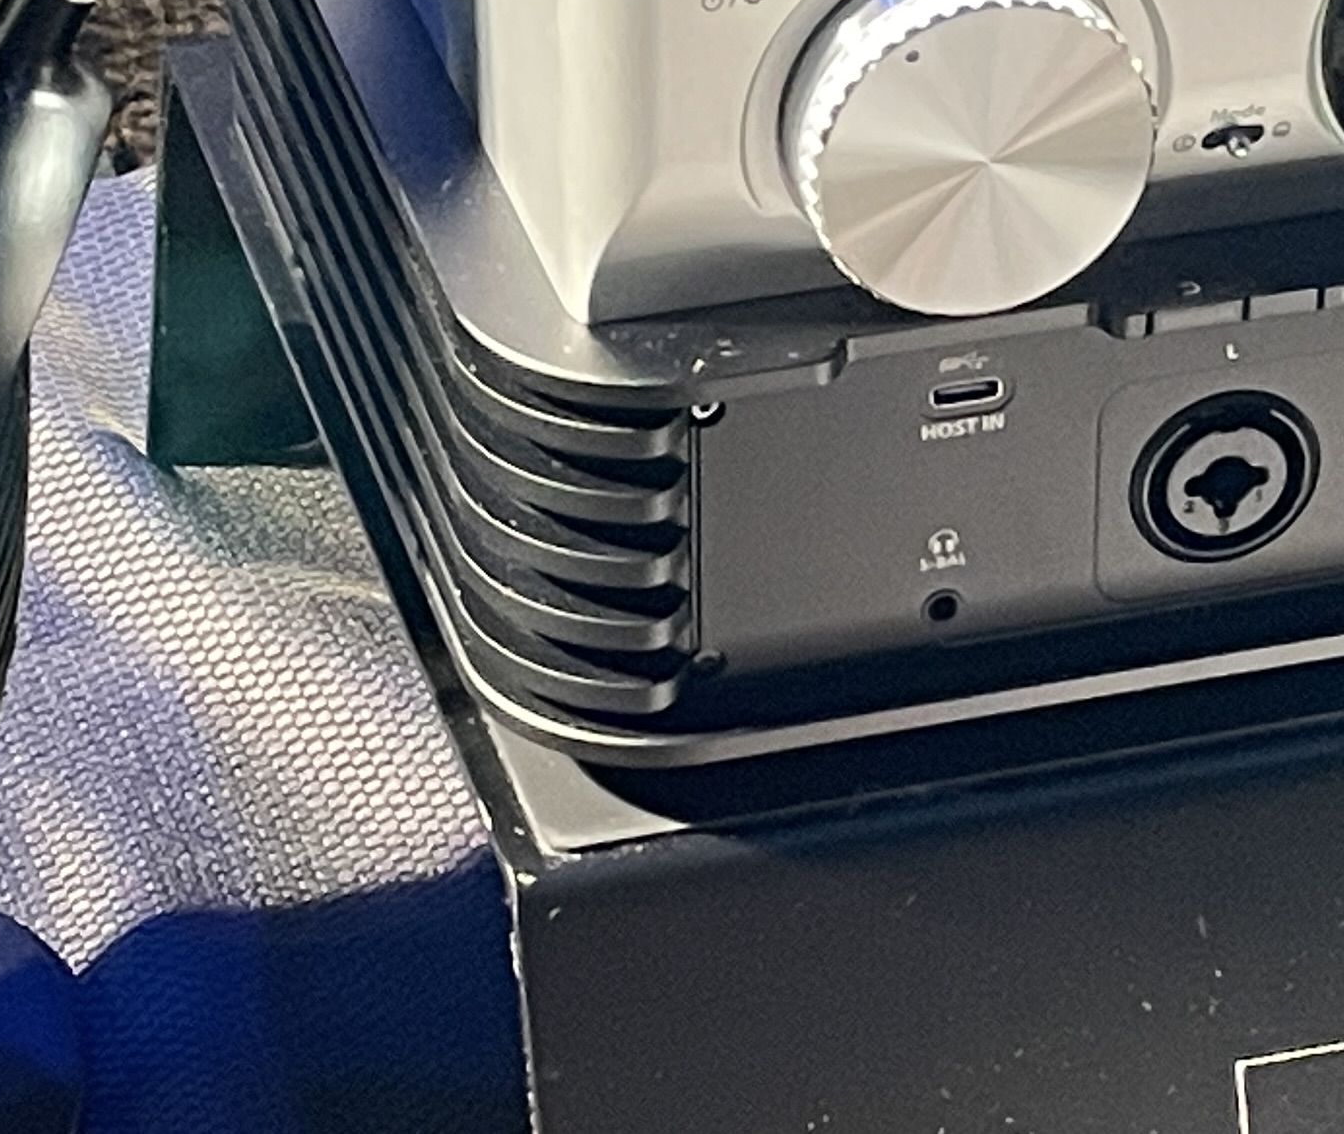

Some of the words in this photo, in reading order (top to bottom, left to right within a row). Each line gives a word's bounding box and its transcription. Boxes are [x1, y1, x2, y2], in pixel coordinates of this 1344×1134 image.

[1226, 342, 1239, 360] L
[920, 415, 980, 442] HOST
[981, 412, 1006, 432] IN
